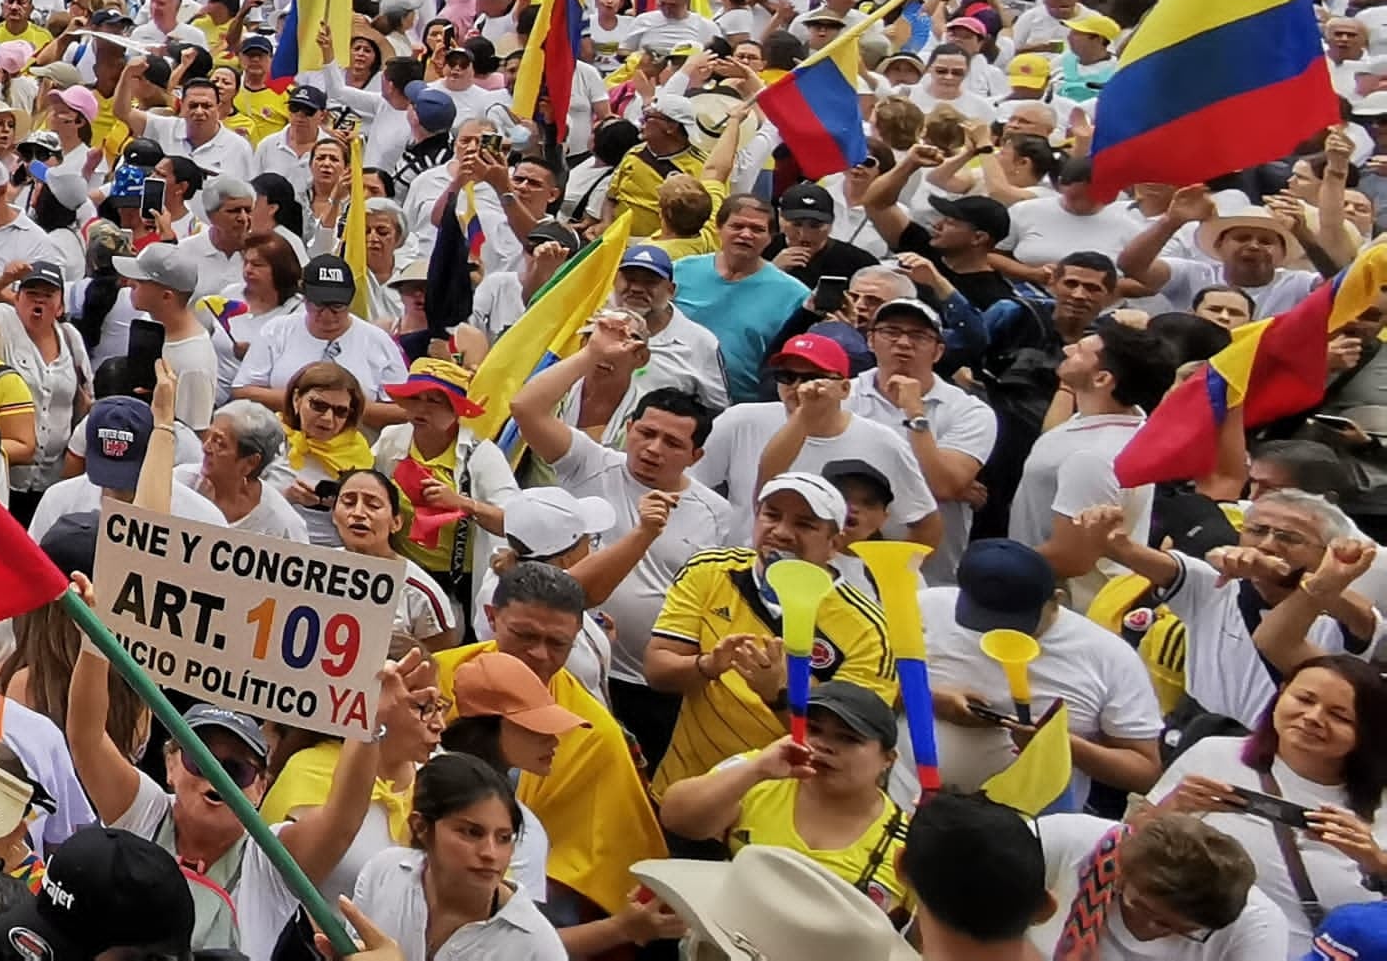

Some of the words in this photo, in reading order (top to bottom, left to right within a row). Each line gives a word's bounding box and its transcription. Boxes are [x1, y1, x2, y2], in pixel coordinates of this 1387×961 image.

[106, 513, 170, 557] CNE
[180, 531, 202, 564] Y
[209, 540, 395, 606] CONGRESO
[111, 571, 227, 651] ART.
[245, 596, 362, 679] 109
[183, 655, 318, 719] POLÍTICO
[327, 685, 370, 731] YA
